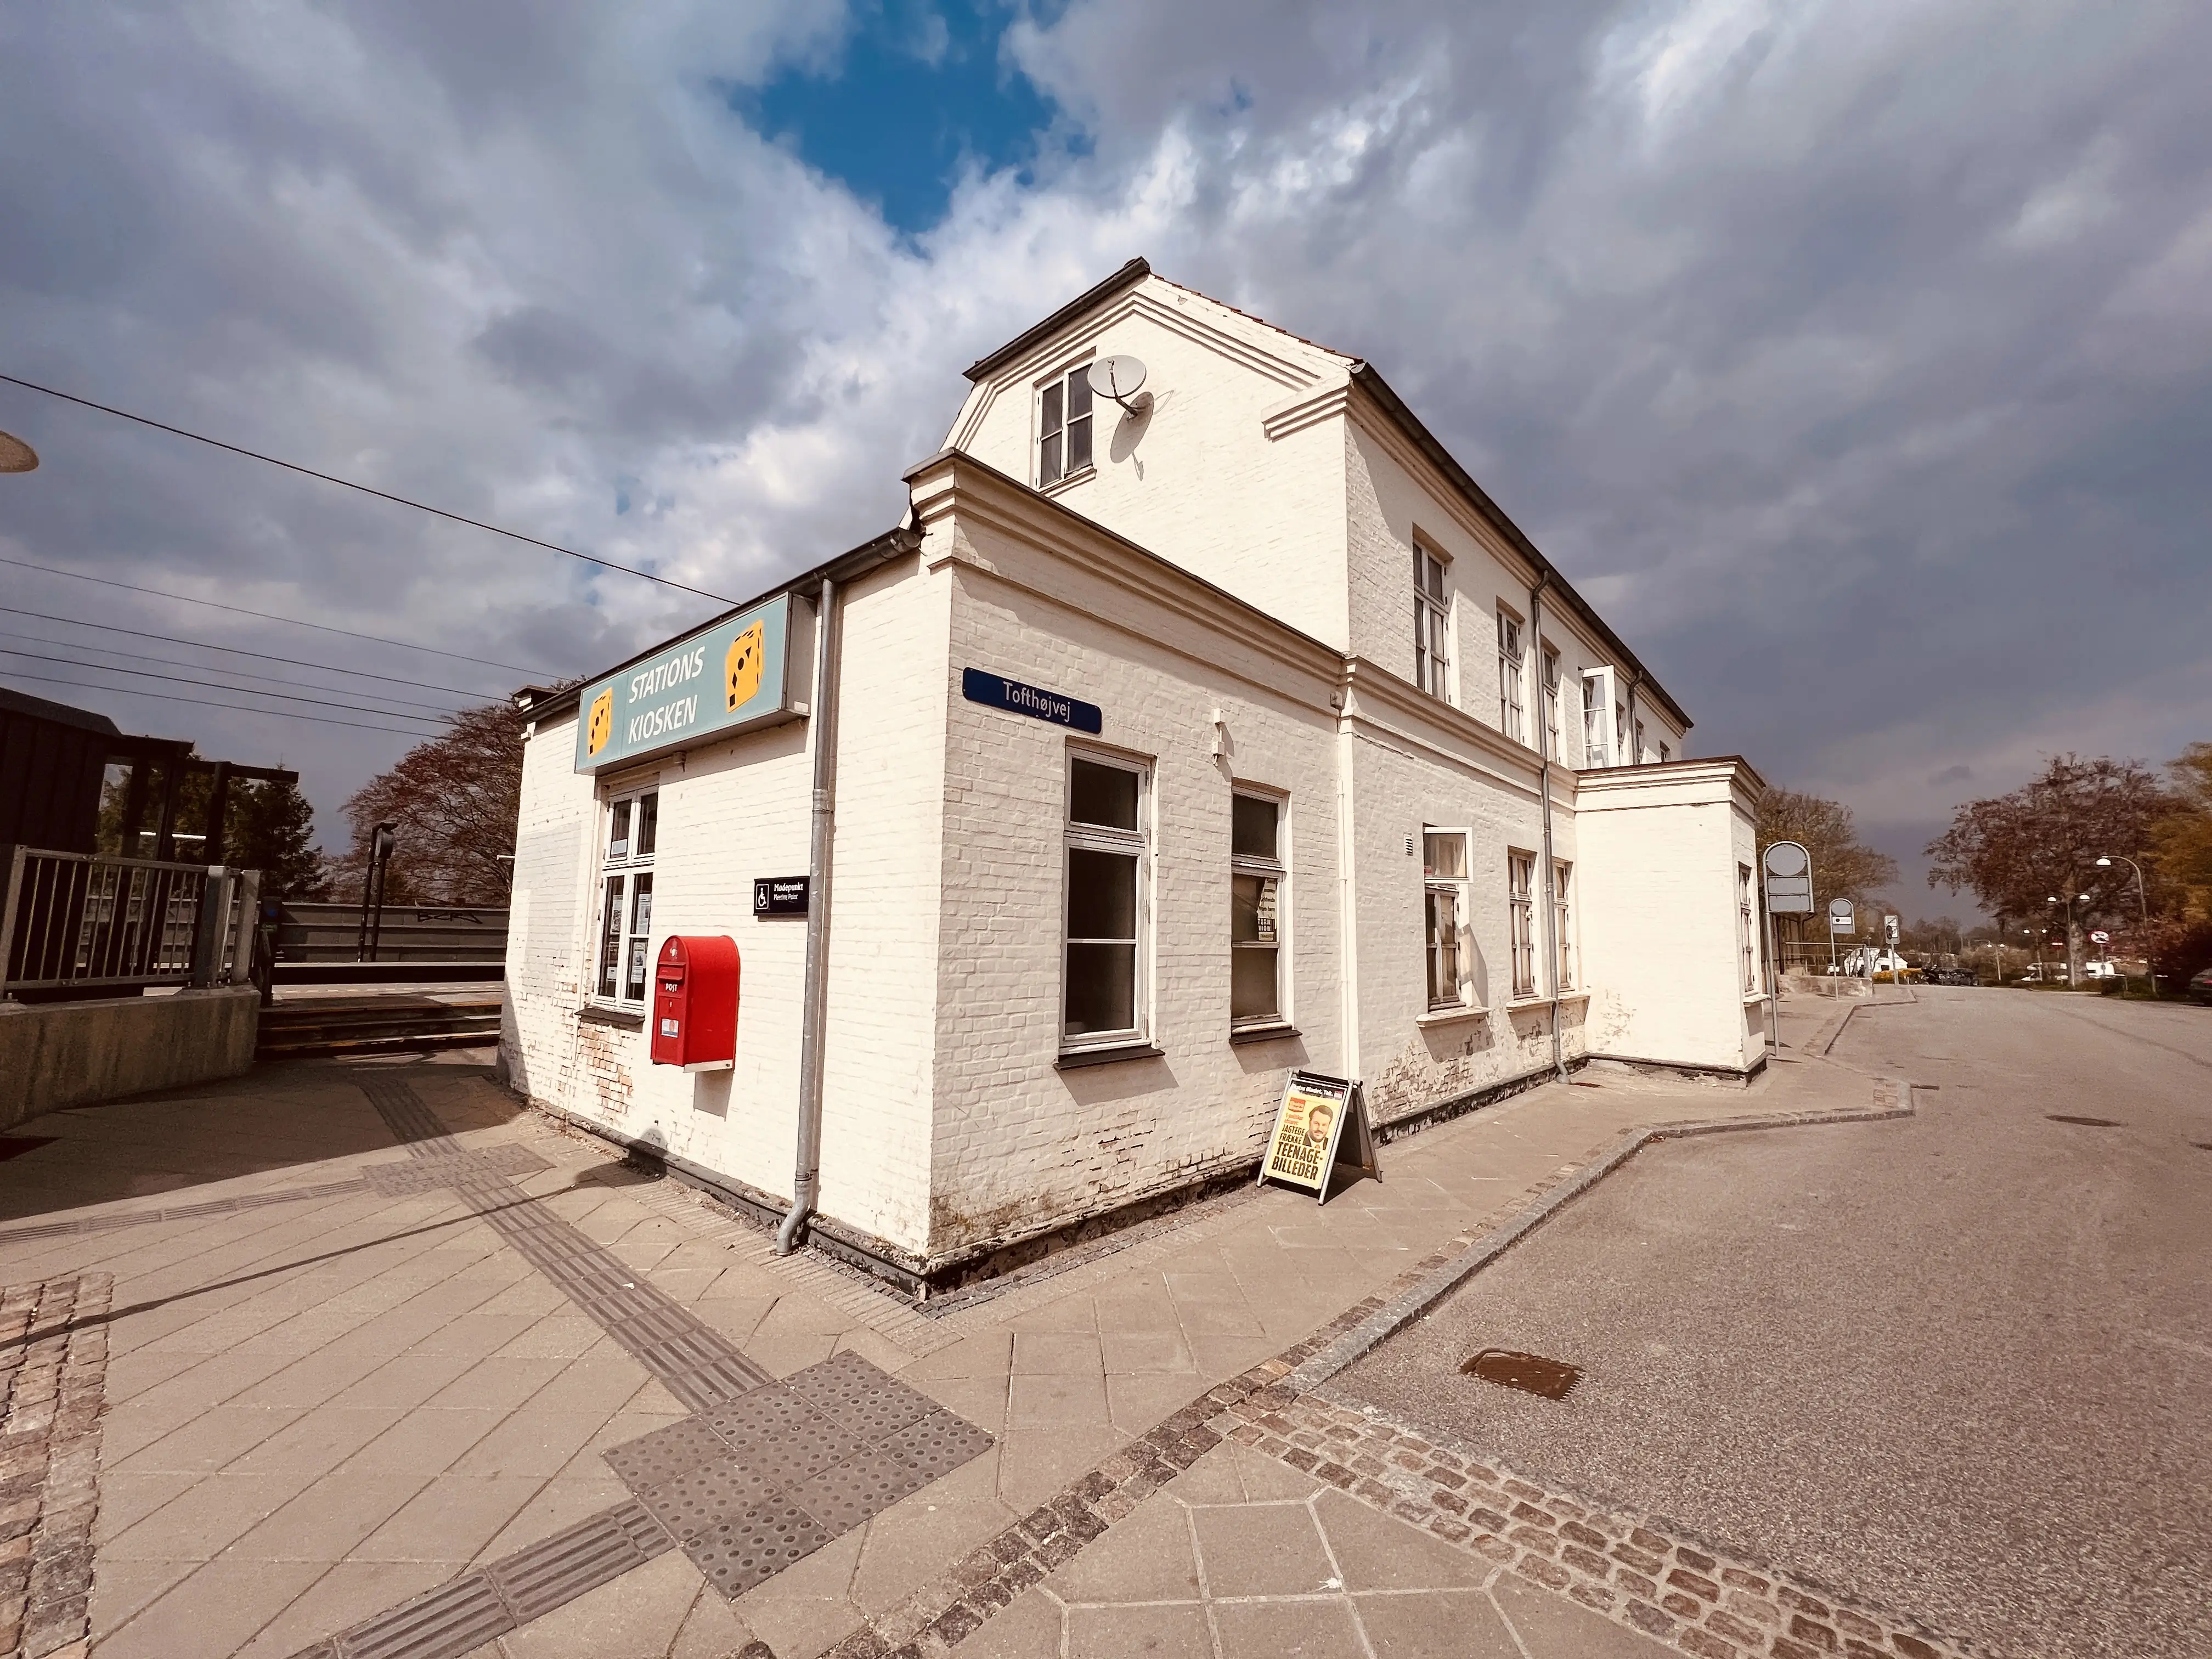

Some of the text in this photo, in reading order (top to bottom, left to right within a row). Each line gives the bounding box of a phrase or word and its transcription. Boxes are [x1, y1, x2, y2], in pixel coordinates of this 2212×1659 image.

[629, 646, 706, 703] STATIONS
[1003, 681, 1070, 723] Tofthøjvej
[628, 695, 698, 744] KIOSKEN
[665, 983, 678, 992] POST
[1279, 1133, 1303, 1145] FRÆKKE
[1282, 1124, 1306, 1136] JAGTEDE
[1277, 1141, 1323, 1164] TEENAGE-
[1272, 1156, 1318, 1181] BILLEDER
